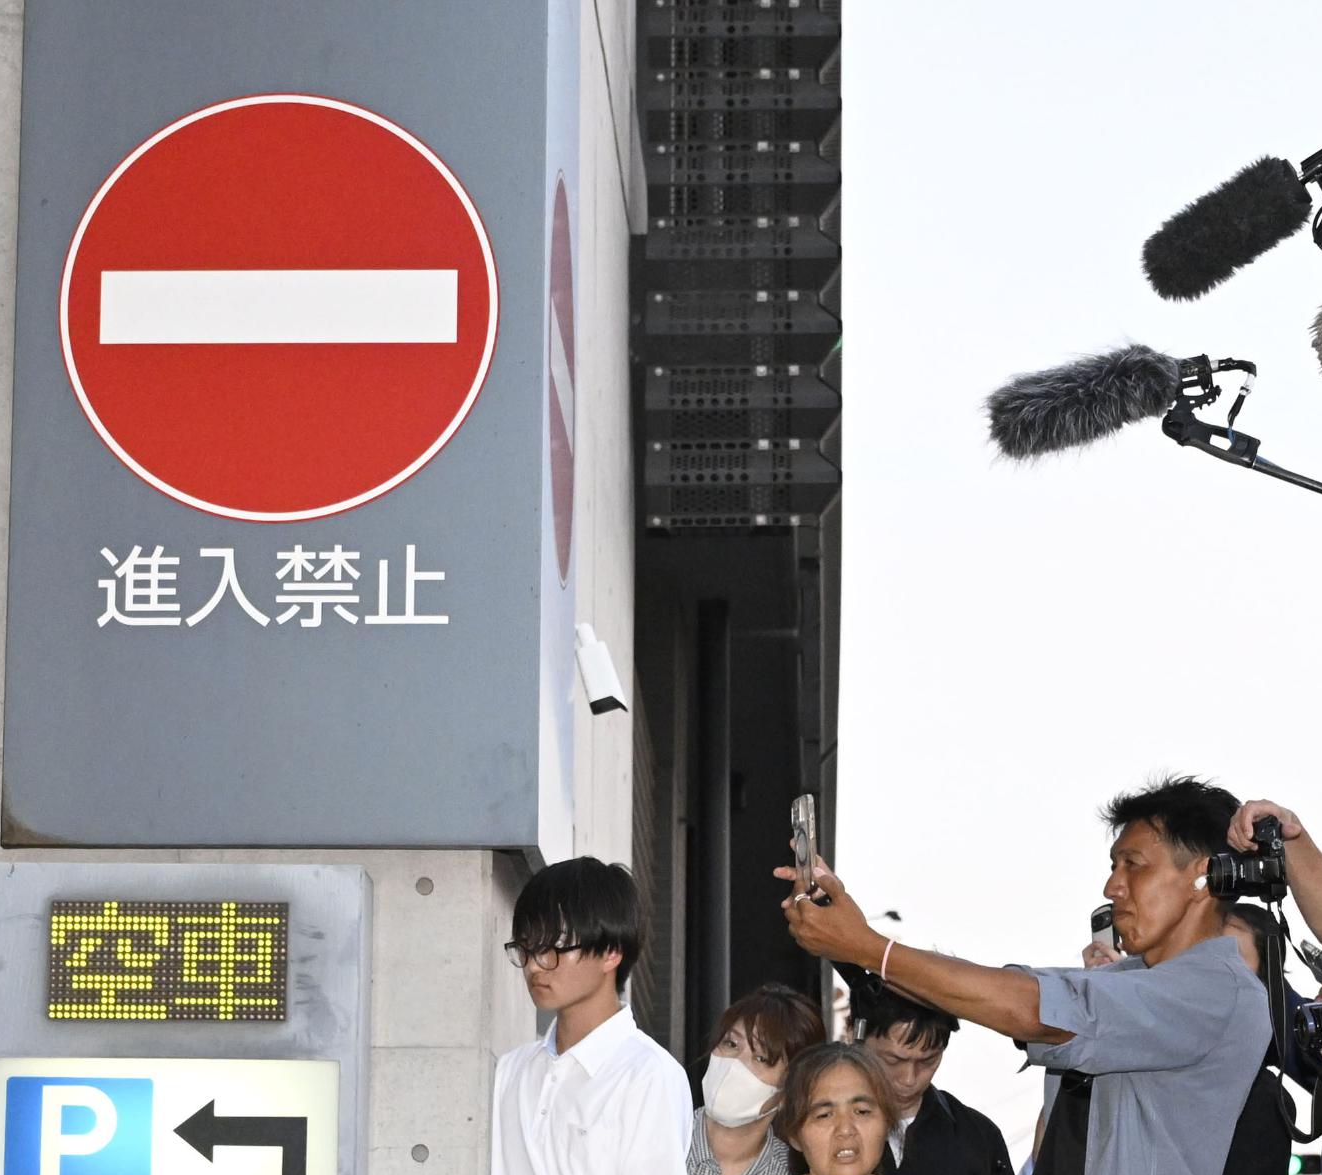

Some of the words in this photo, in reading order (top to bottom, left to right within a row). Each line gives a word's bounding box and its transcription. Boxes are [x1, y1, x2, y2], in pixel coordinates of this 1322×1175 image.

[96, 544, 449, 629] 進入禁止
[48, 901, 280, 1020] 空車
